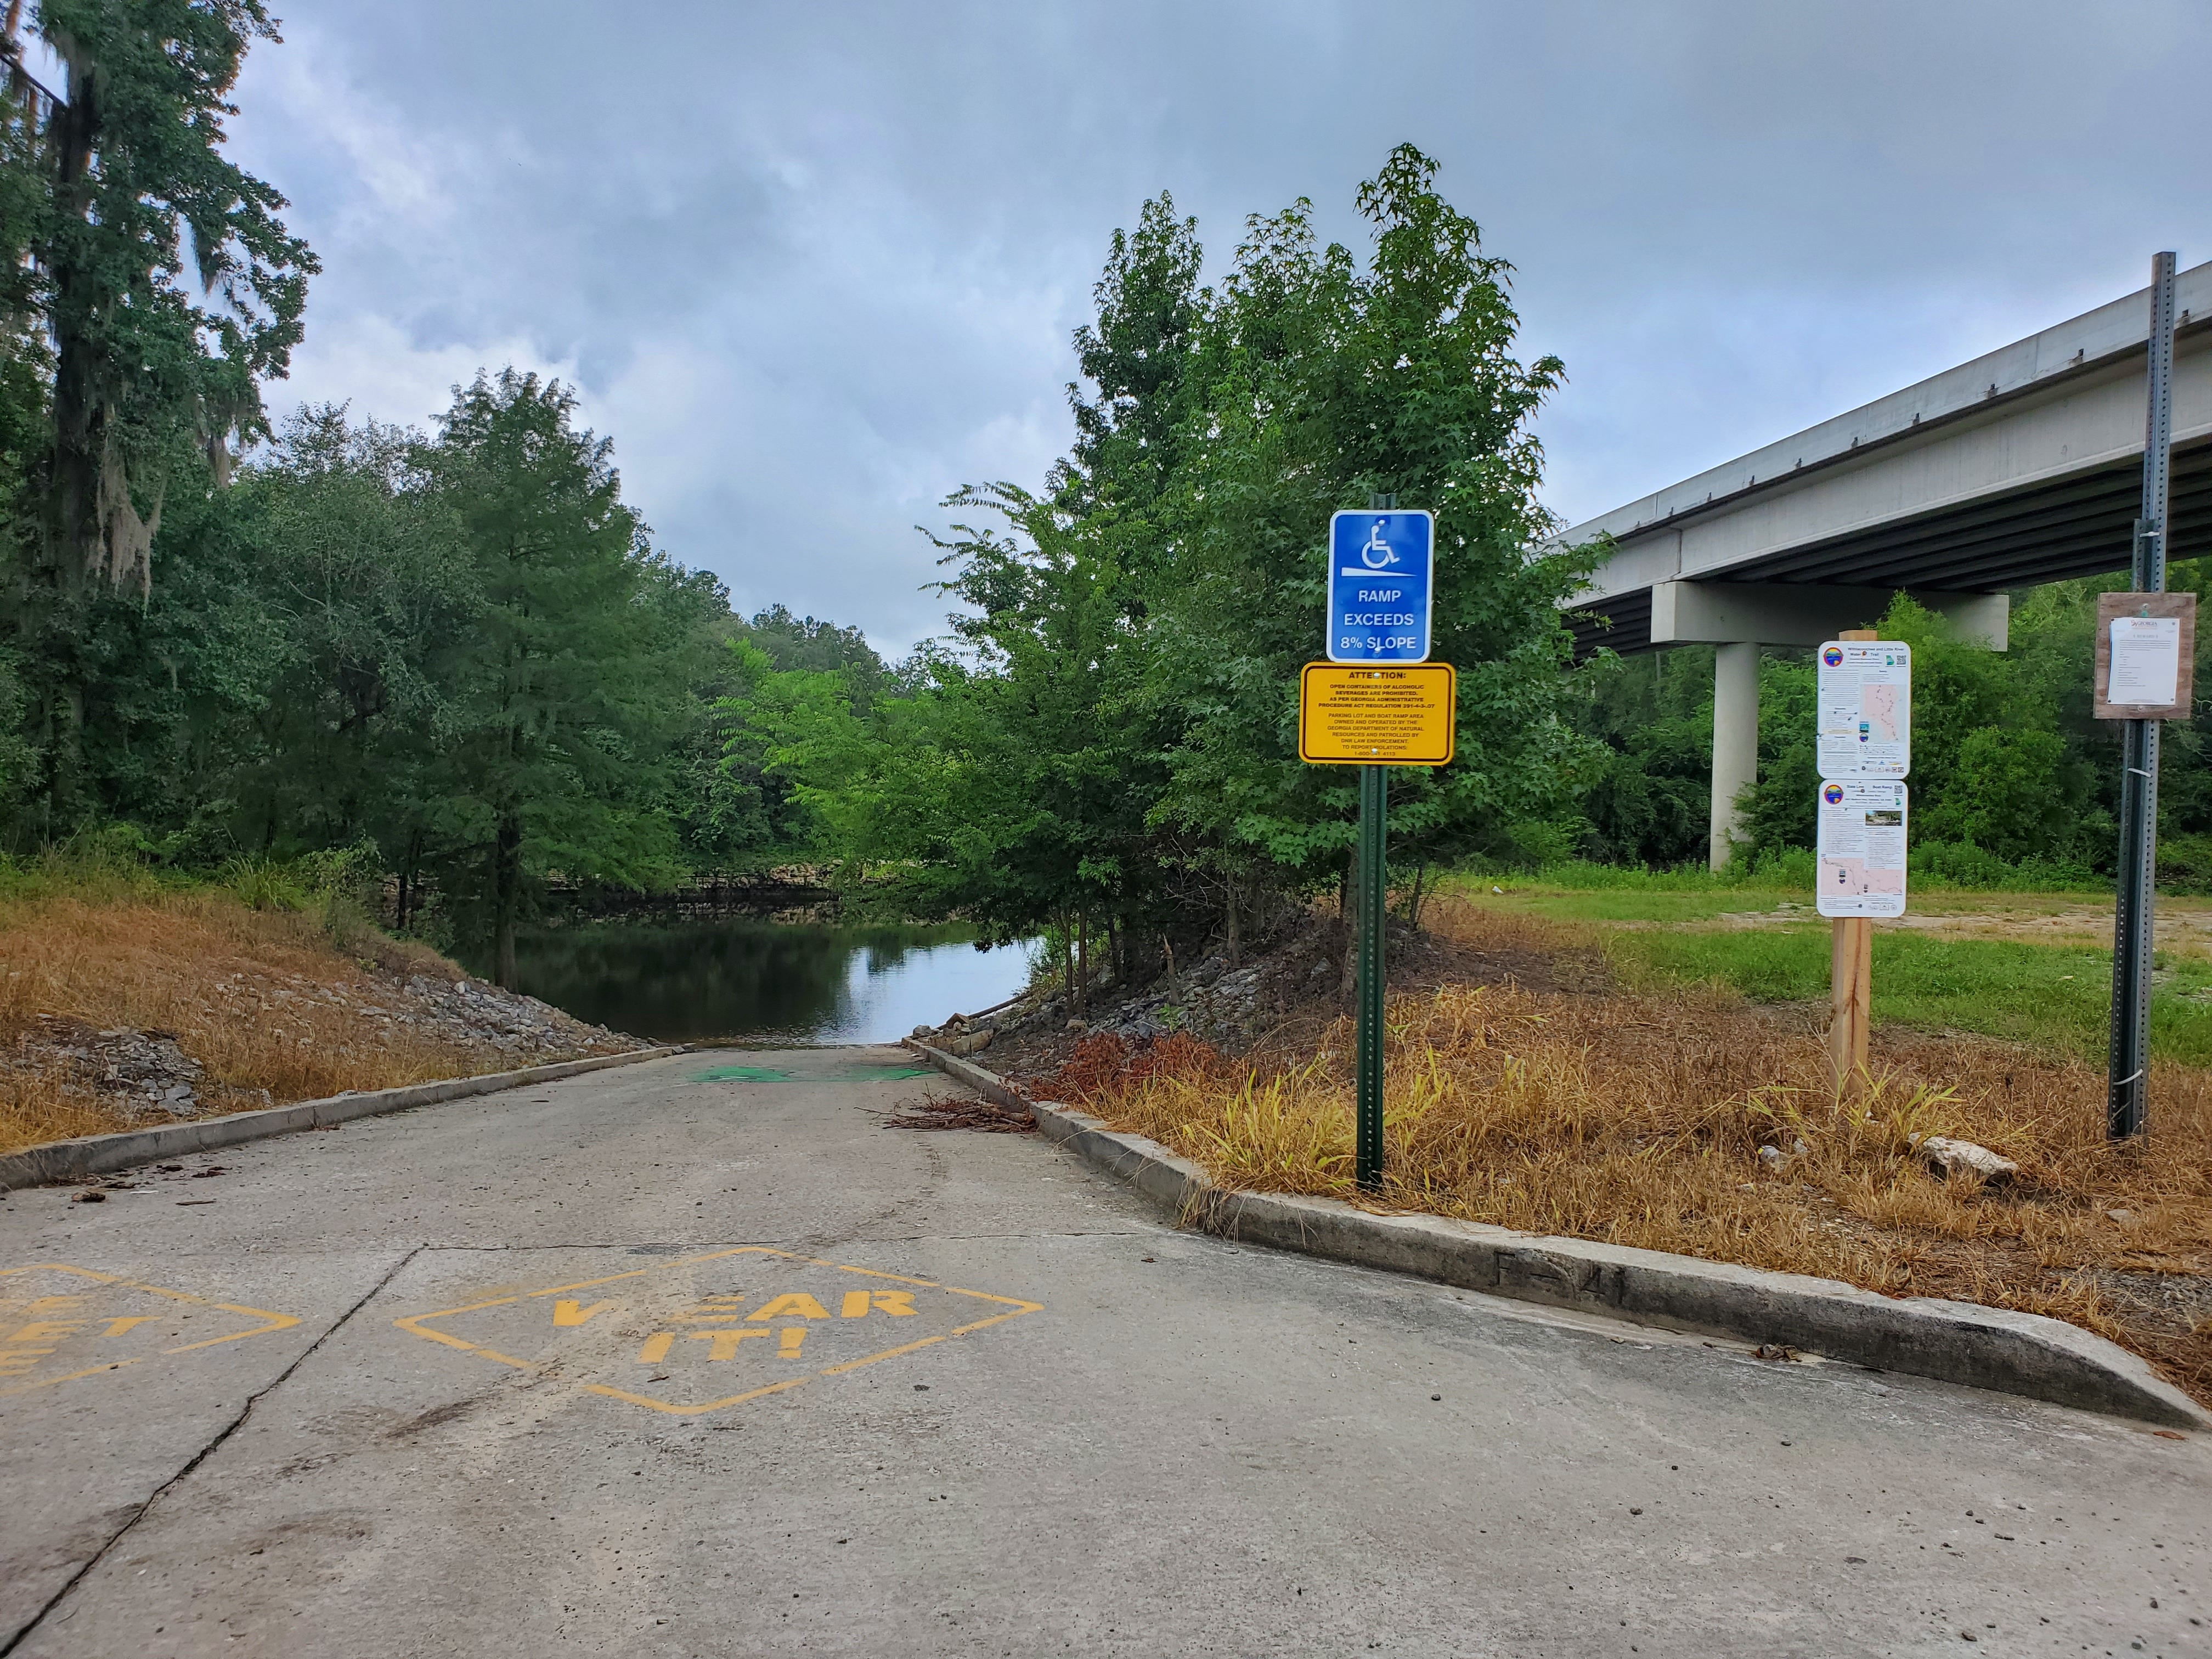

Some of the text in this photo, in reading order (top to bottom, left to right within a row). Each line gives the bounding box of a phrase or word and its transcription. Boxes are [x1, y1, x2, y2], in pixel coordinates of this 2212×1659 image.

[1358, 590, 1402, 602] RAMP
[1344, 613, 1414, 626] EXCEEDS
[1340, 637, 1417, 649] 8% SLOPE
[637, 1327, 808, 1363] IT!
